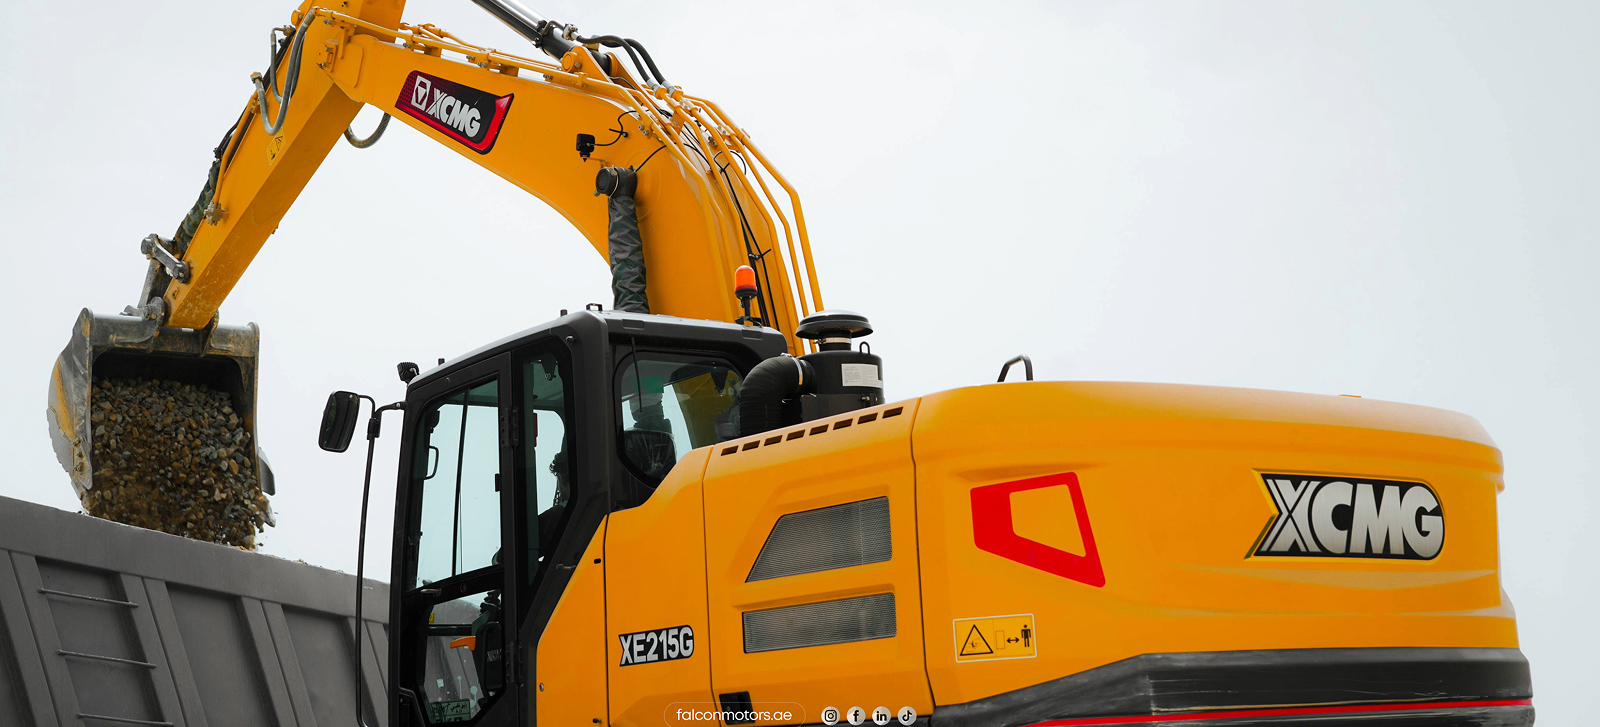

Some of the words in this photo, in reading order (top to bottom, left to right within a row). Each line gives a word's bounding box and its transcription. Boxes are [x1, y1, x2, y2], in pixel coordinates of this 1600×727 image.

[425, 87, 481, 138] XCMG
[1258, 478, 1444, 558] XCMG
[619, 626, 694, 665] XE215G
